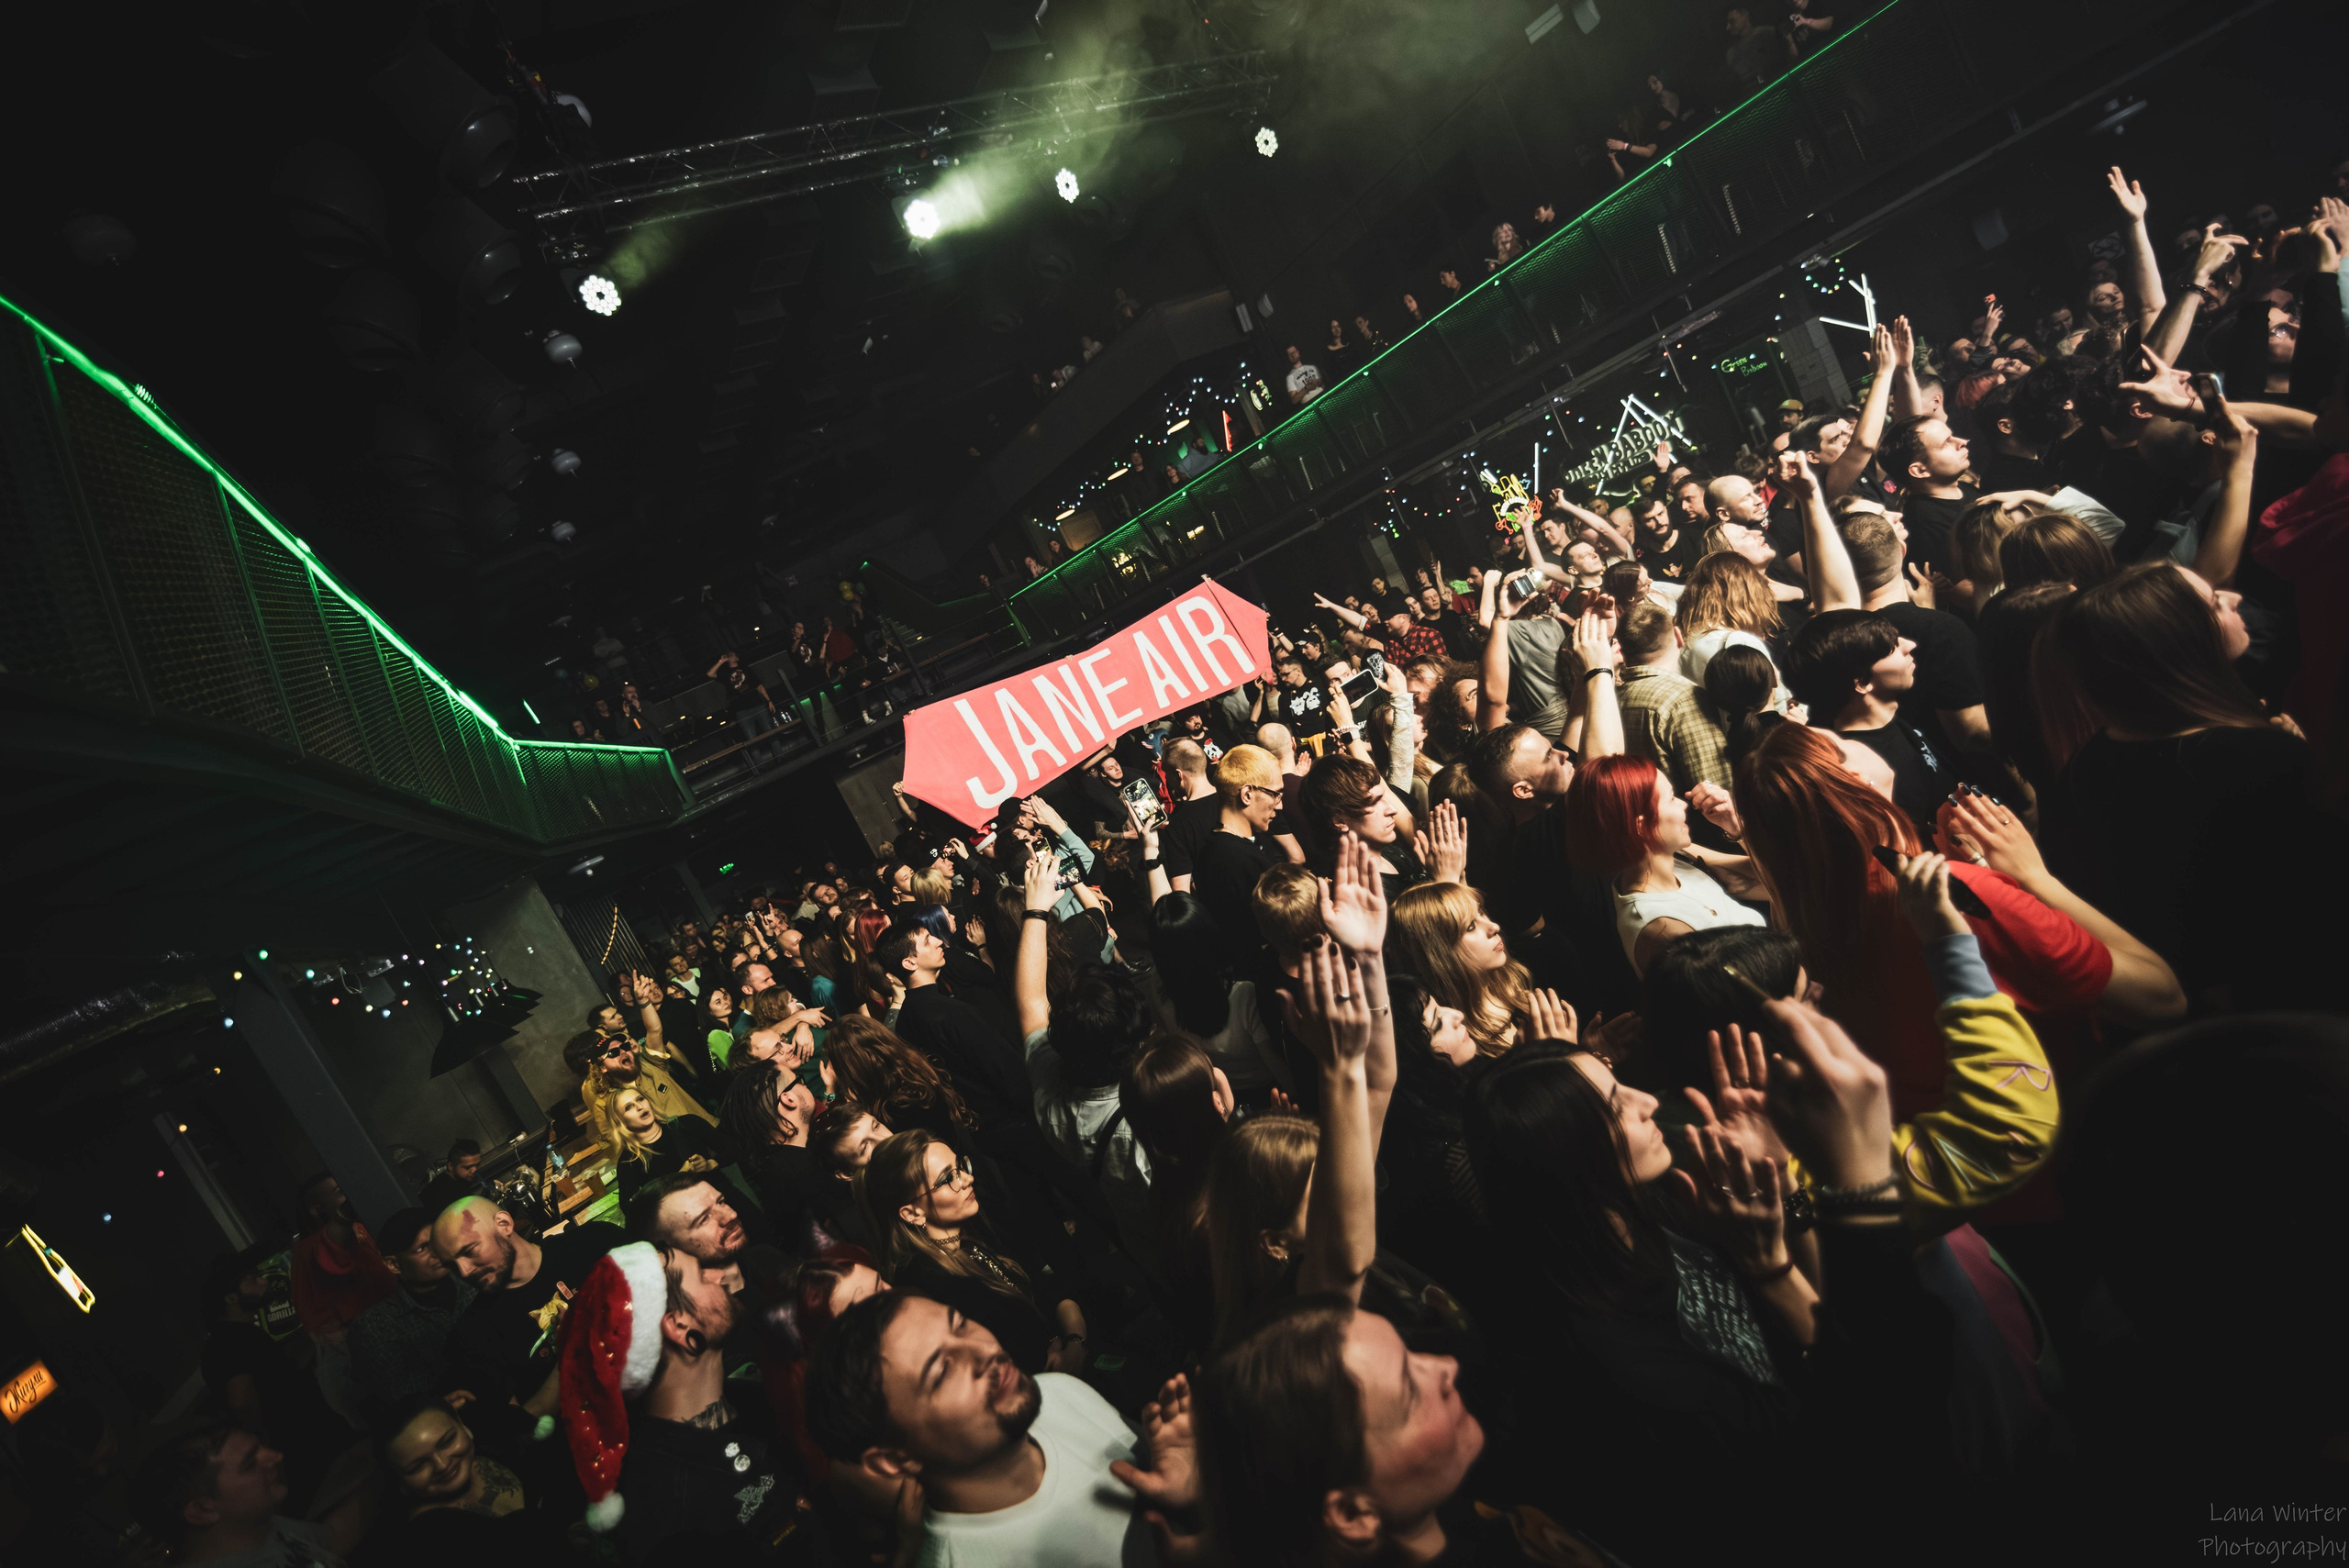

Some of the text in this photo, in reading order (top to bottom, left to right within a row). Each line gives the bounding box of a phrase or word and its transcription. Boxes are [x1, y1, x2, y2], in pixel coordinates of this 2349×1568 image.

[953, 595, 1256, 809] JANE AIR
[5, 1370, 45, 1414] Жигули
